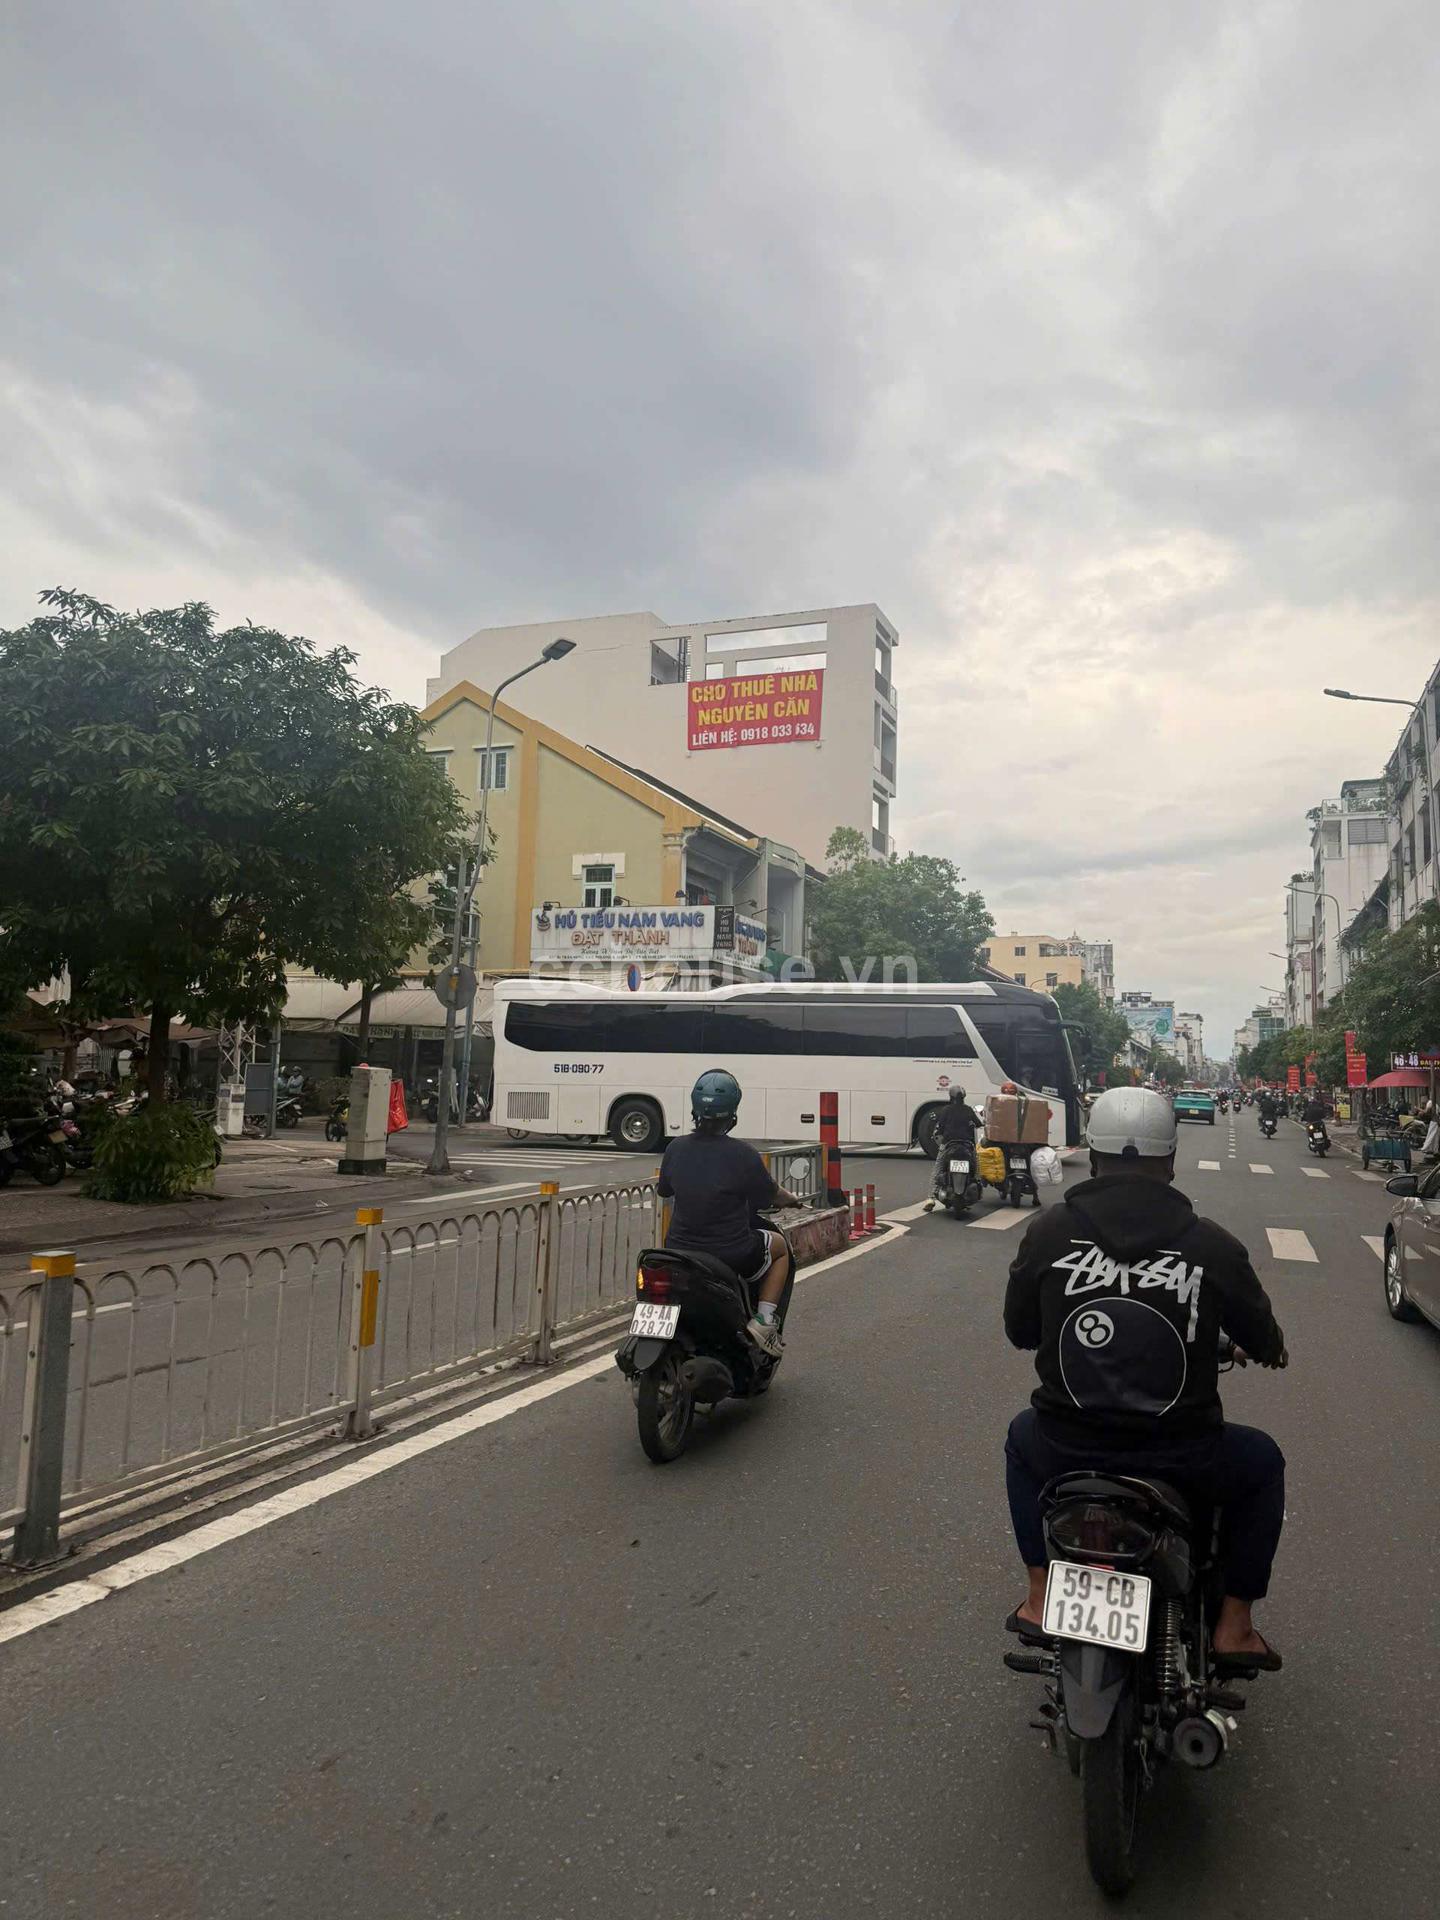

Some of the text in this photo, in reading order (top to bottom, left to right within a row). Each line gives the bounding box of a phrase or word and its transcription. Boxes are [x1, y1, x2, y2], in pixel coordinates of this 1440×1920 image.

[692, 671, 818, 703] CHO THUÊ NHÀ
[698, 696, 810, 726] NGUYÊN CĂN
[692, 730, 717, 746] LIÊN
[720, 728, 738, 745] HỆ:
[740, 726, 768, 741] 0918
[771, 723, 792, 737] 033
[555, 907, 705, 929] HỦ TIẾU NAM VANG
[571, 928, 670, 950] ĐẠT THÀNH
[640, 1304, 673, 1321] 49-AA
[631, 1319, 674, 1337] 028.70
[1063, 1567, 1136, 1609] 59-CB
[1056, 1599, 1141, 1645] 134.05
